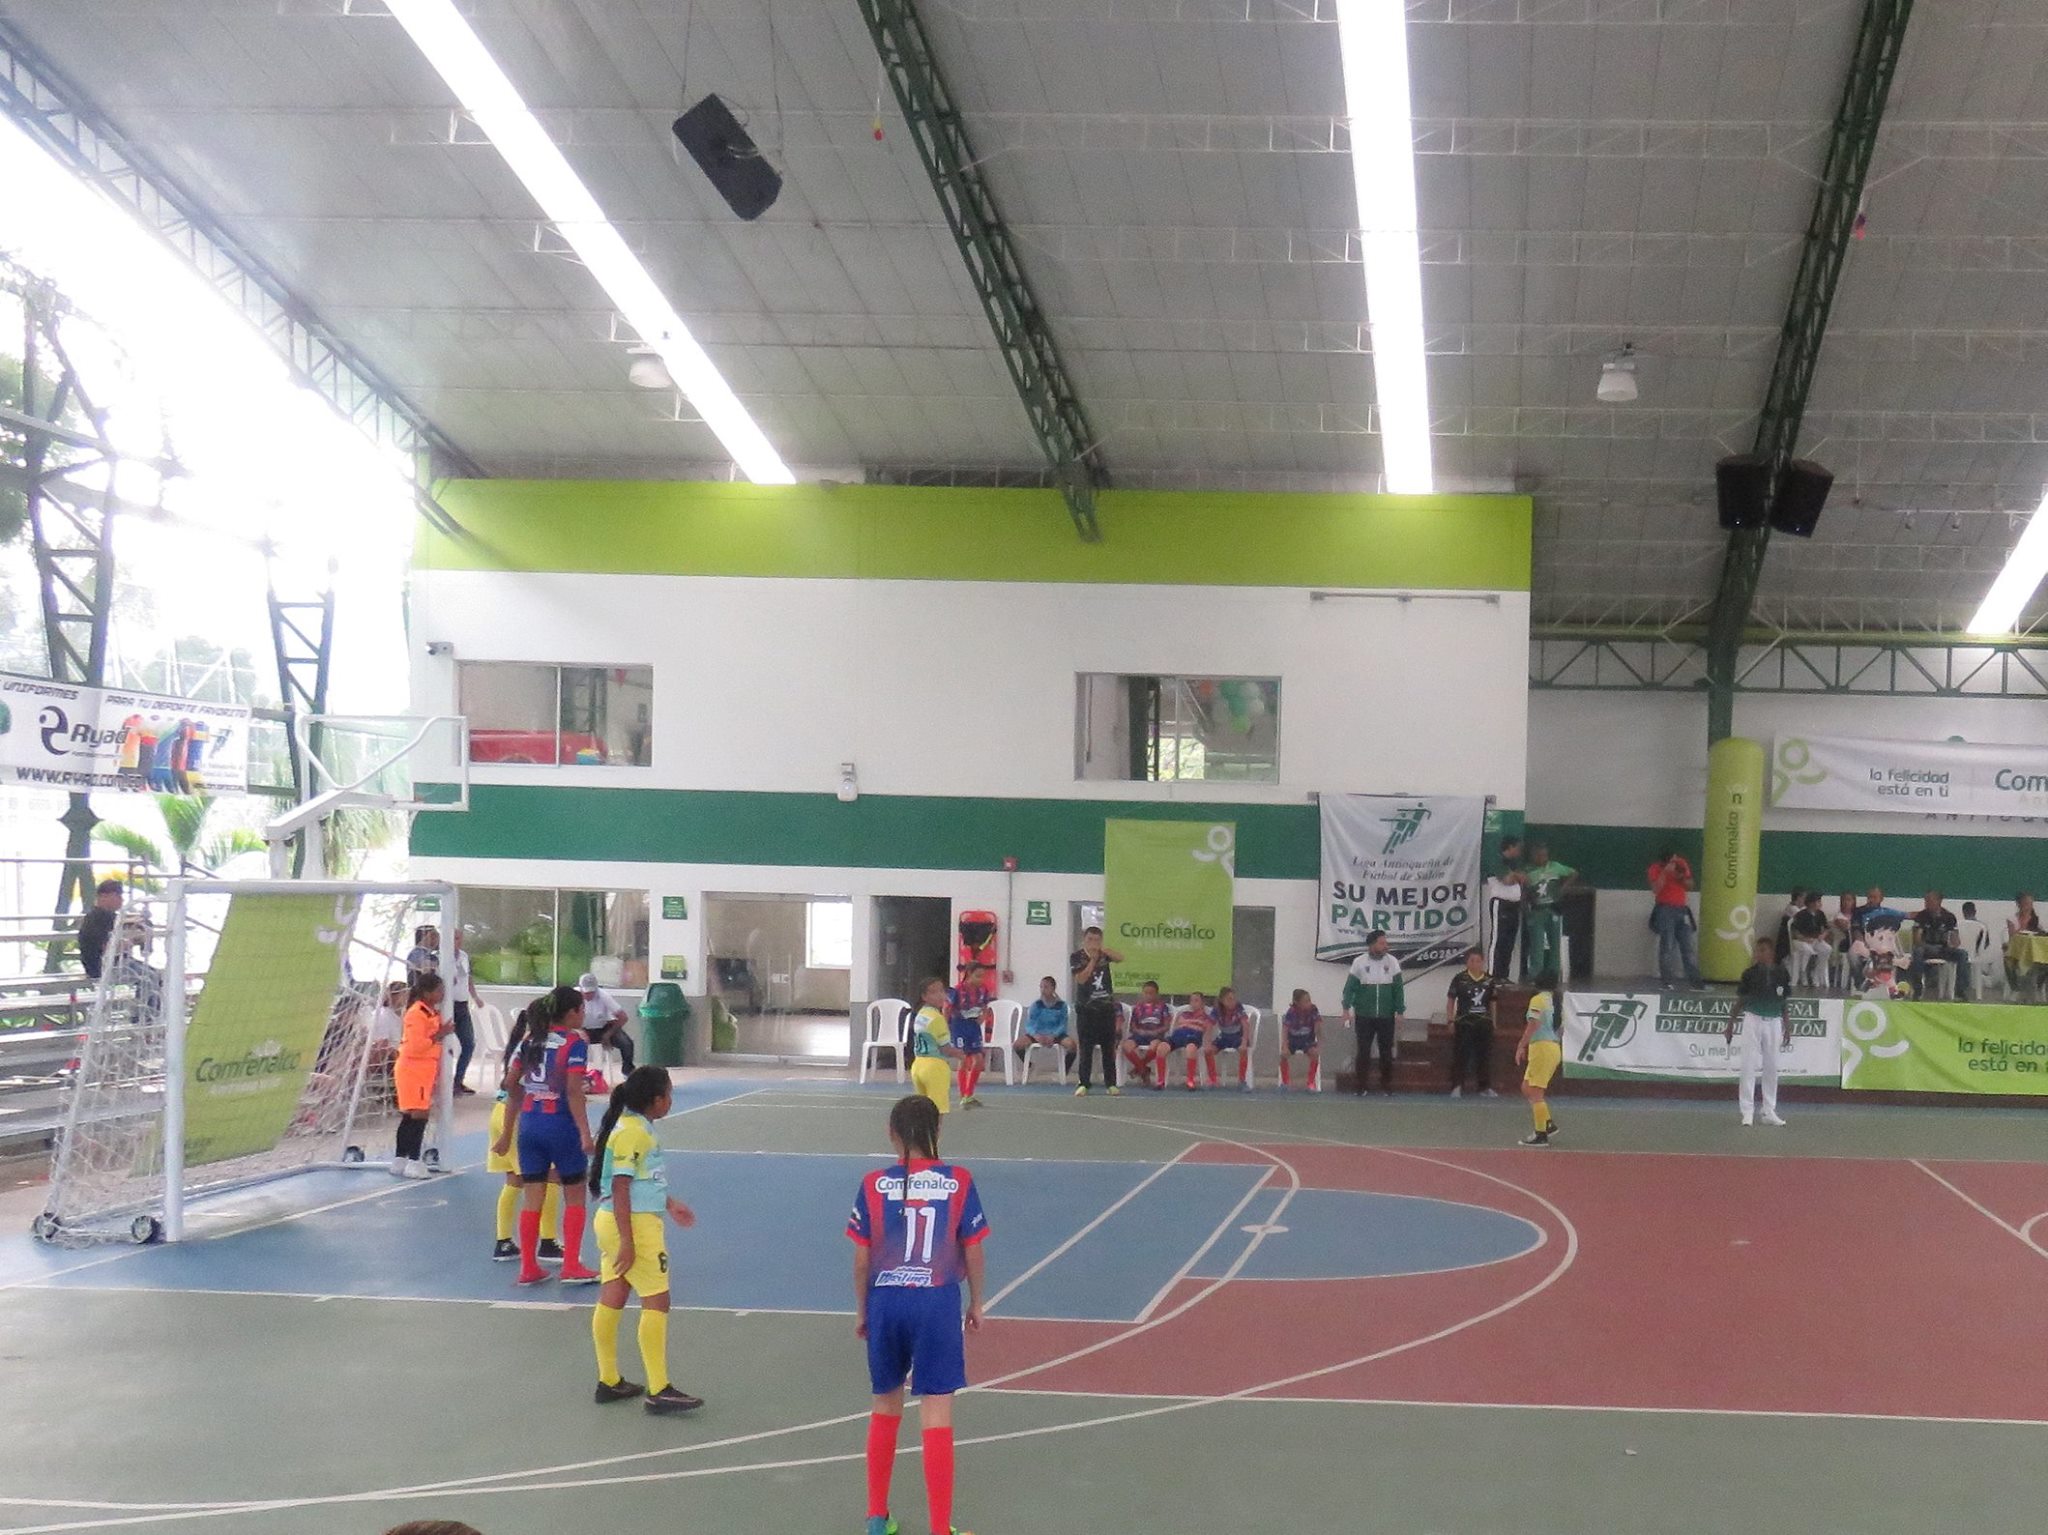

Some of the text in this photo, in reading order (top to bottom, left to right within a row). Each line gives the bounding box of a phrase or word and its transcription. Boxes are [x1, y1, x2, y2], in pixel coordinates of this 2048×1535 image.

[3, 681, 79, 700] UNIFORMES
[70, 723, 130, 748] Ryad
[1869, 768, 1949, 784] la felicidad
[1877, 782, 1949, 798] está en ti
[1724, 811, 1739, 889] Comfenalco
[1333, 880, 1467, 909] SU MEJOR
[1331, 902, 1468, 931] PARTIDO
[1120, 922, 1216, 940] Comfenalco
[1667, 999, 1704, 1014] LIGA
[1659, 1019, 1681, 1032] DE
[1689, 1043, 1705, 1058] Su
[1958, 1036, 2048, 1058] la felicida
[2016, 1060, 2038, 1072] en
[878, 1176, 958, 1192] Comfenalco
[899, 1206, 936, 1263] 11
